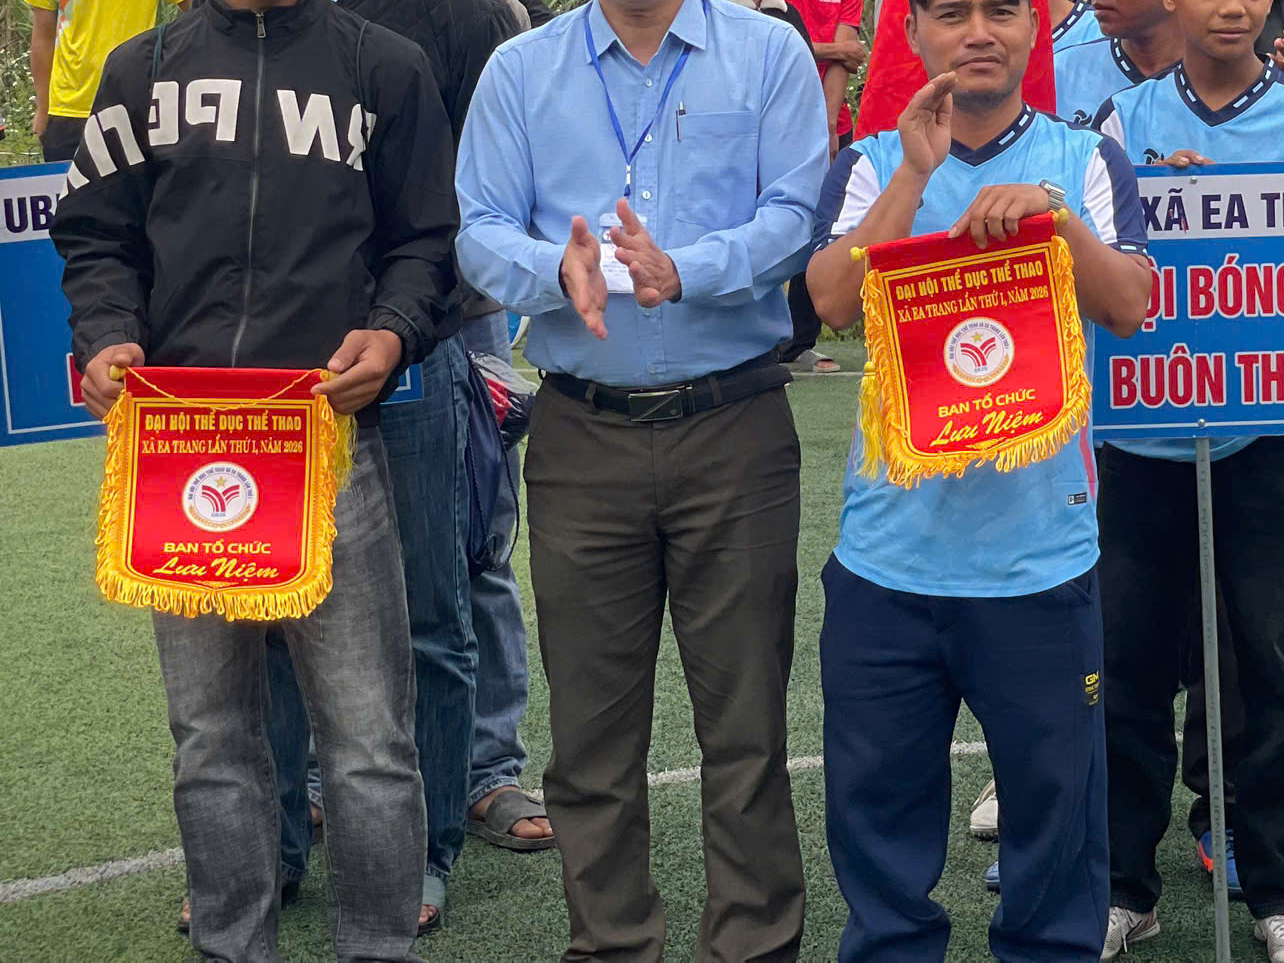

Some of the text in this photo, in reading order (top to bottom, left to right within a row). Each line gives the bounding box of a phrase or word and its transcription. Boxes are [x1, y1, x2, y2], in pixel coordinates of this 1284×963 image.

[1141, 188, 1189, 233] XÃ
[1201, 194, 1249, 229] EA
[896, 260, 1044, 301] ĐẠI HỘI THỂ DỤC THỂ THAO
[1142, 255, 1177, 331] ỘI
[912, 303, 926, 320] EA
[926, 300, 958, 318] TRANG
[1030, 285, 1049, 300] 2026
[1109, 343, 1226, 409] BUÔN
[938, 389, 1036, 418] BAN TỔ CHỨC
[145, 410, 302, 434] ĐẠI HỘI THỂ DỤC THỂ THAO
[982, 410, 1043, 434] Niệm
[157, 439, 171, 453] EA
[173, 439, 206, 454] TRANG
[284, 440, 303, 453] 2026
[164, 539, 272, 554] BAN TỔ CHỨC
[211, 557, 279, 582] Niệm
